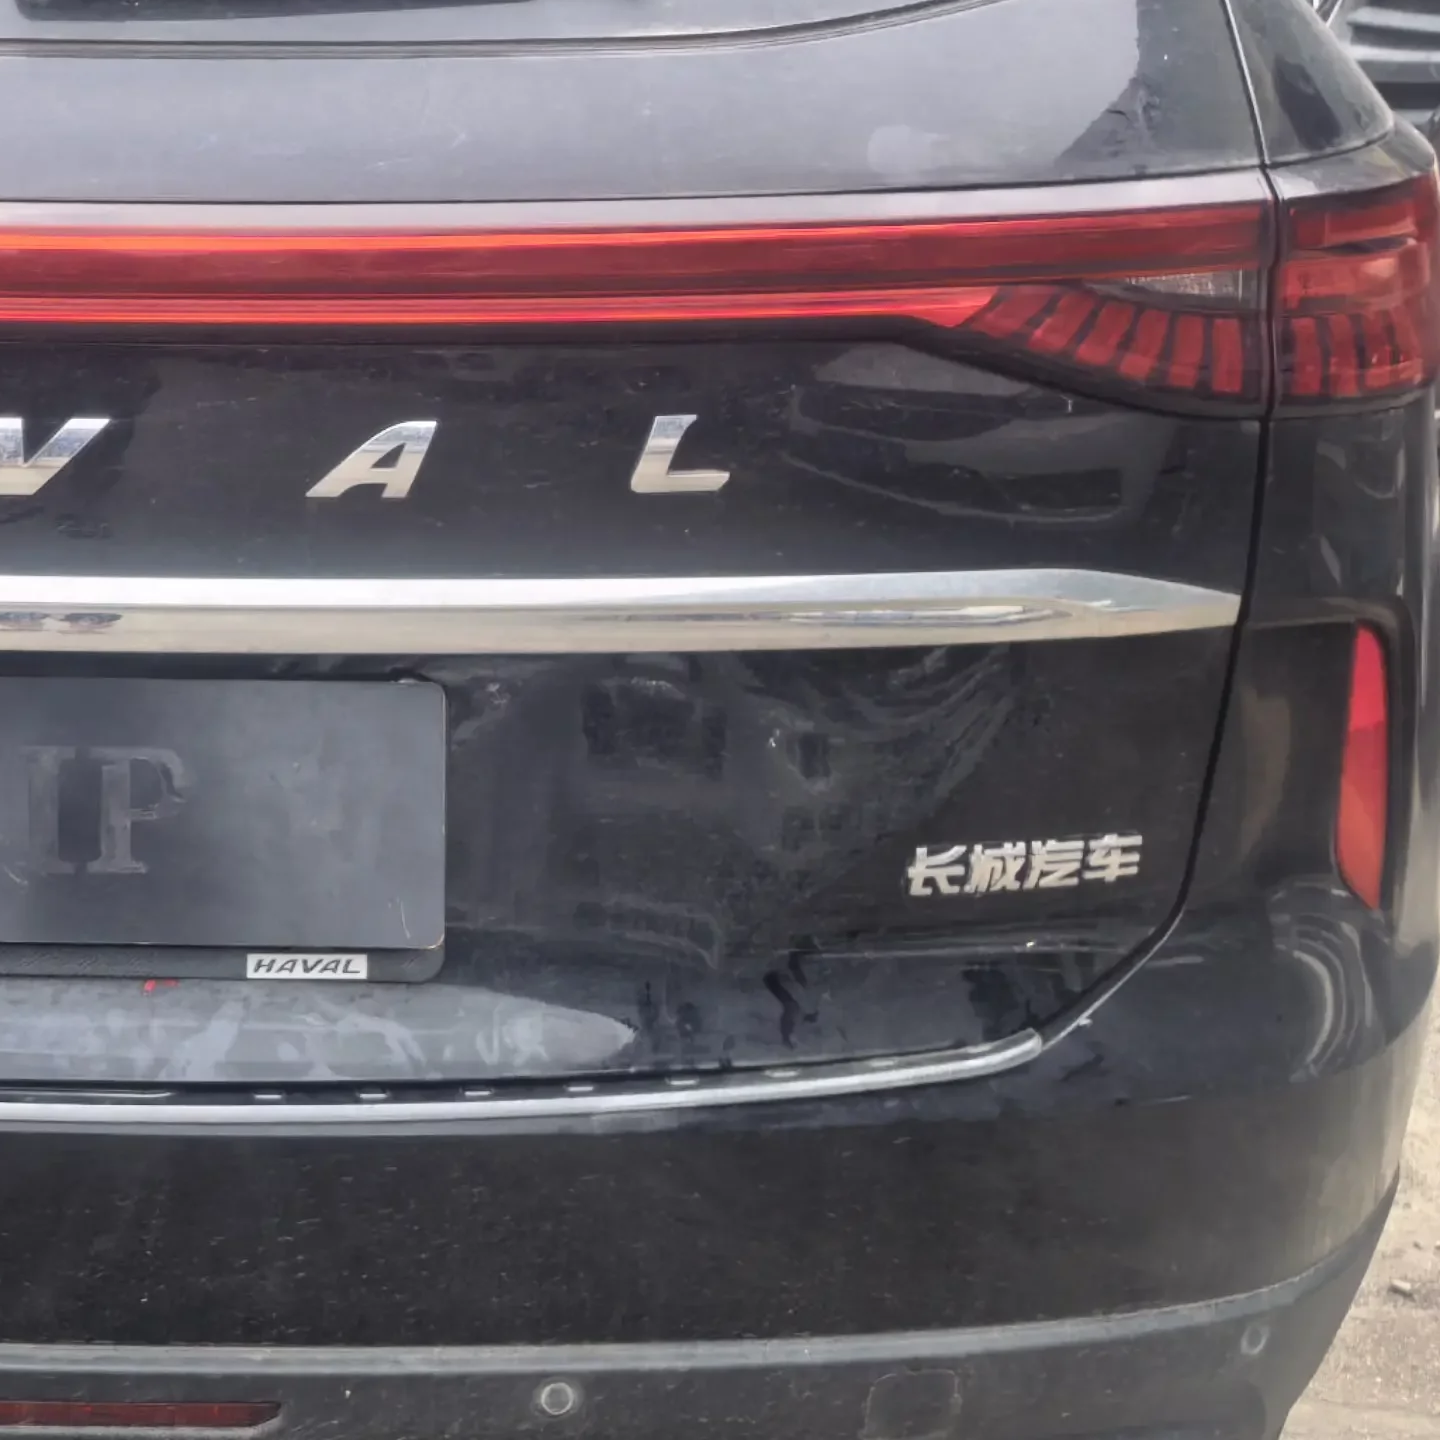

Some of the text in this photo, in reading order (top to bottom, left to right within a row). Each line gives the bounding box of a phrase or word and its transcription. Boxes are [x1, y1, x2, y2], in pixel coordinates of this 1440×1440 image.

[907, 833, 1143, 896] 长城汽车
[252, 957, 361, 974] HAVAL
